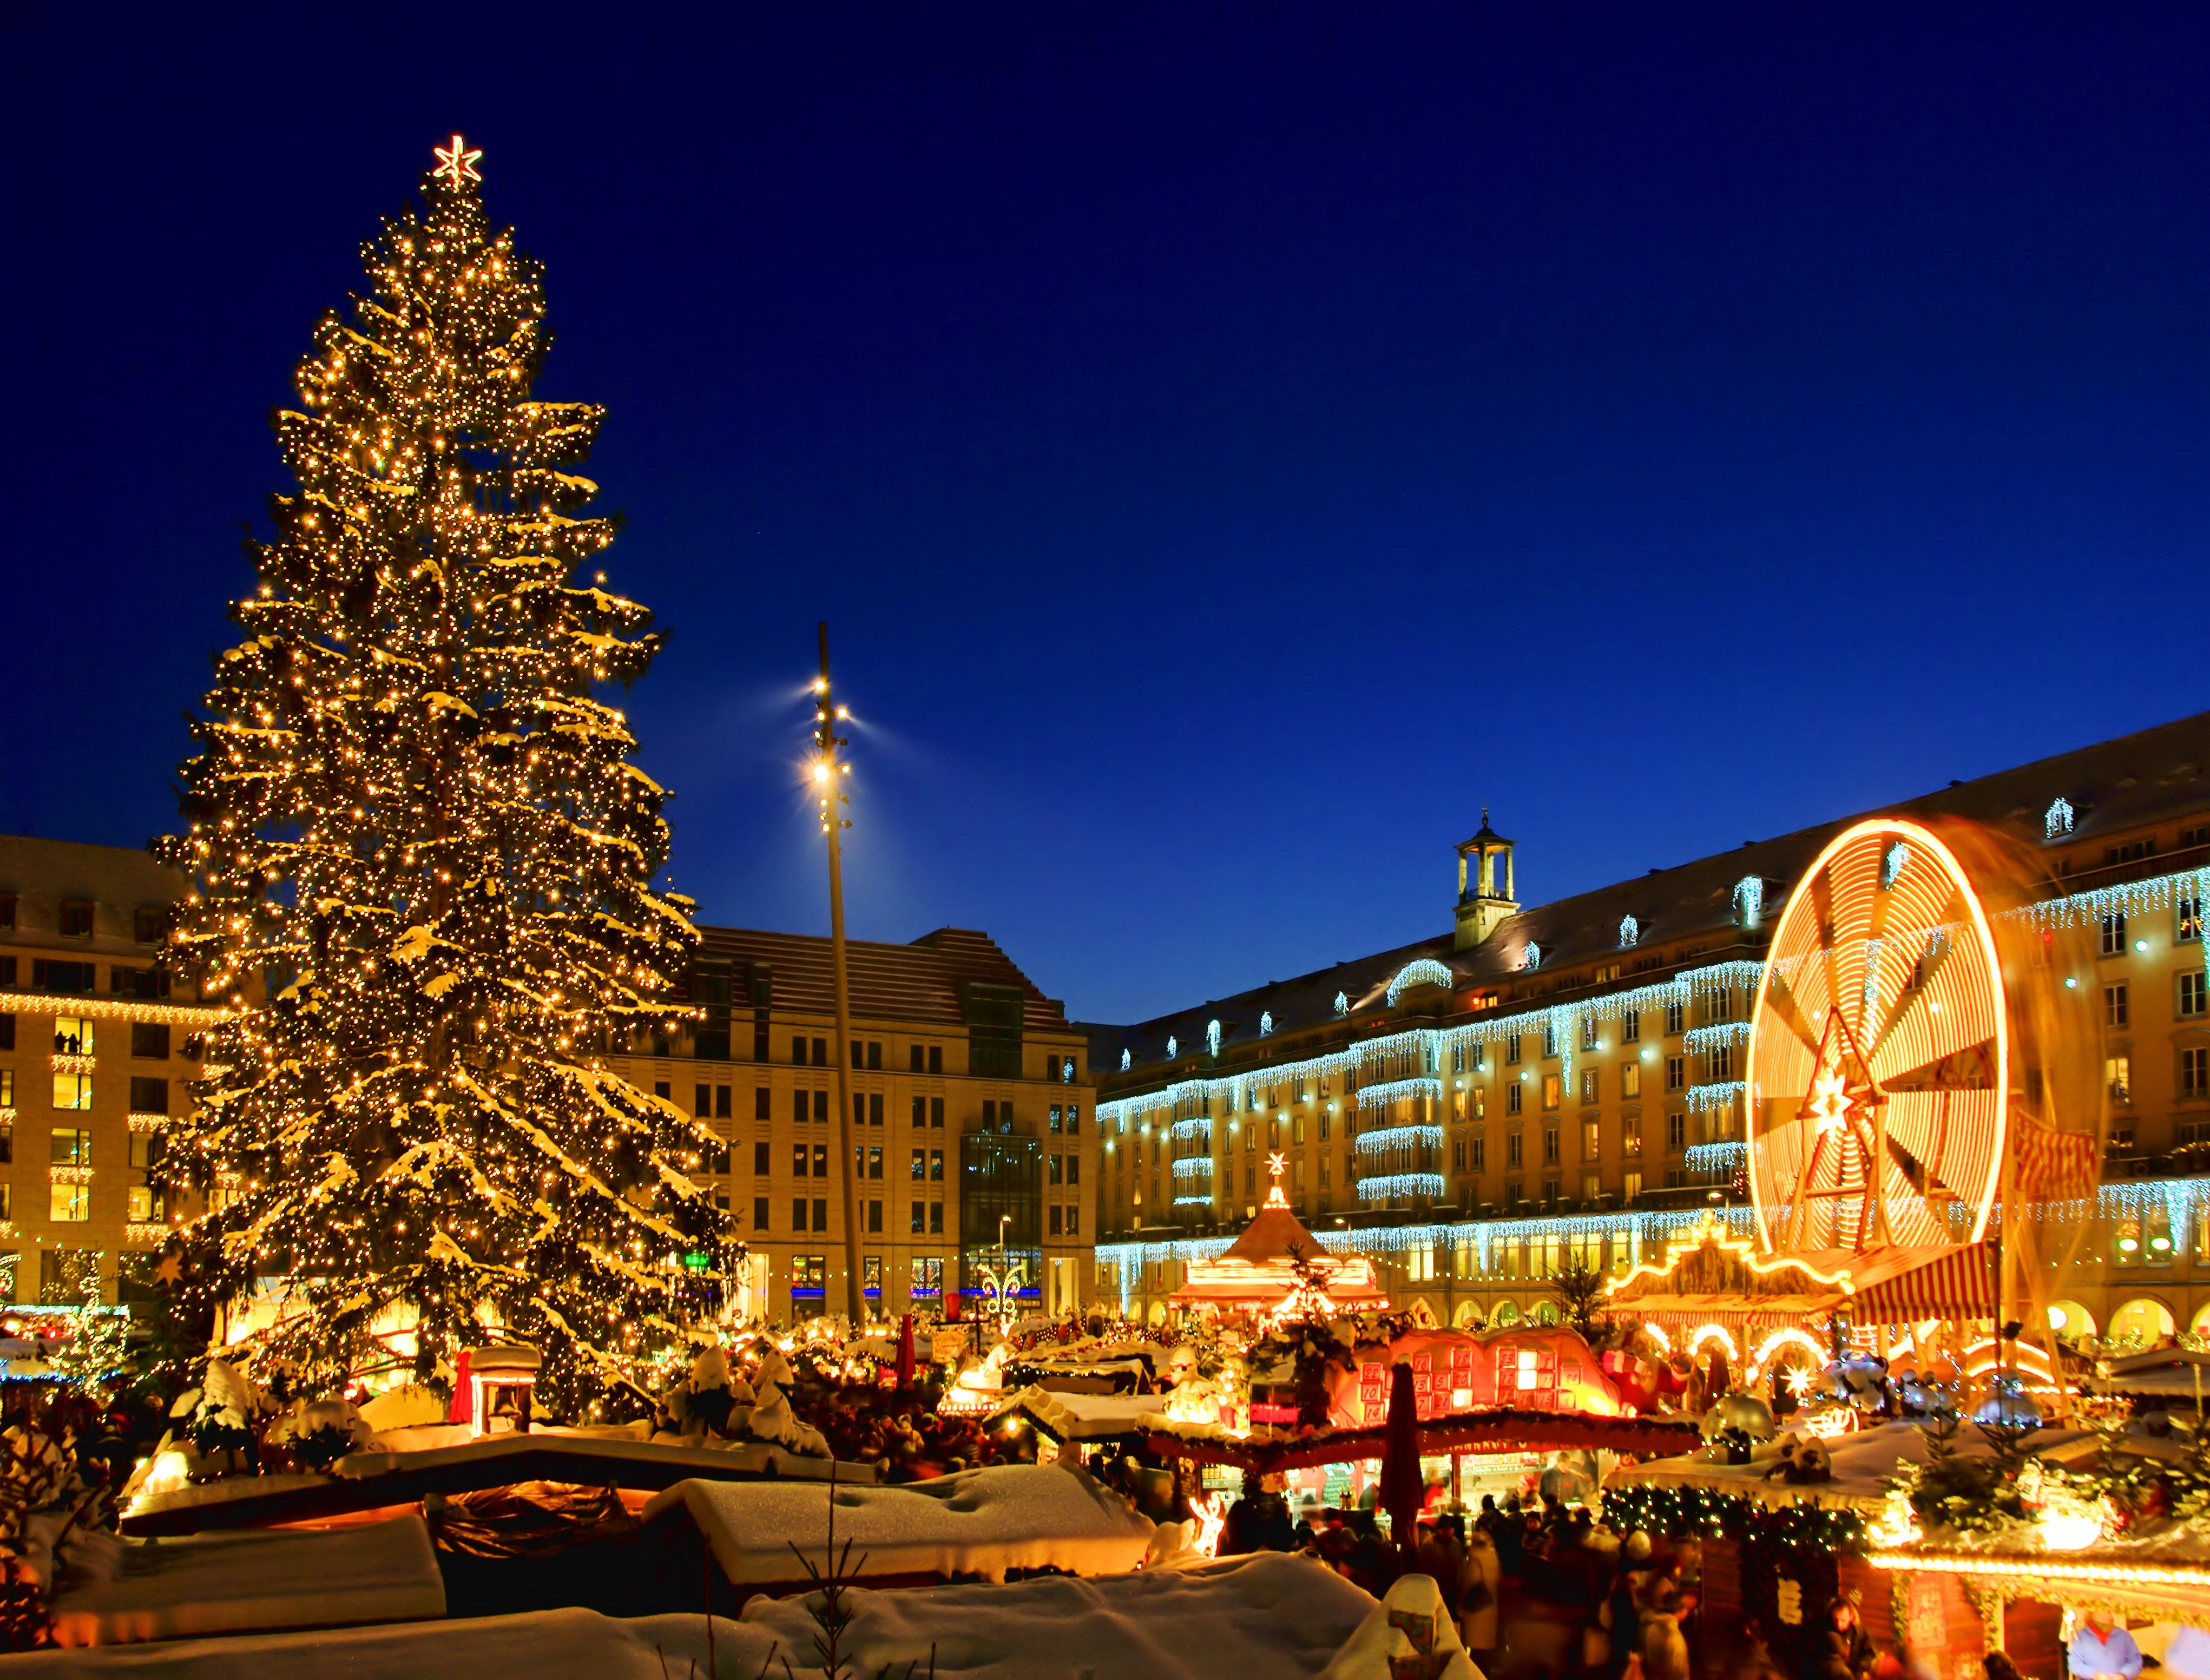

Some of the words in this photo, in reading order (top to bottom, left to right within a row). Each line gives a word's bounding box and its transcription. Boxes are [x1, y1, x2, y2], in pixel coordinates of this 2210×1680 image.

[1456, 1355, 1468, 1365] 18
[1501, 1354, 1513, 1363] 23
[1416, 1359, 1426, 1369] 16
[1365, 1368, 1378, 1379] 22
[1502, 1374, 1513, 1383] 17
[1414, 1380, 1426, 1390] 13
[1437, 1377, 1443, 1387] 5
[1455, 1375, 1467, 1385] 20
[1543, 1377, 1552, 1386] 11
[1364, 1388, 1377, 1398] 10
[1419, 1400, 1425, 1409] 7
[1436, 1397, 1448, 1406] 21
[1541, 1395, 1552, 1405] 15
[1367, 1408, 1379, 1418] 14
